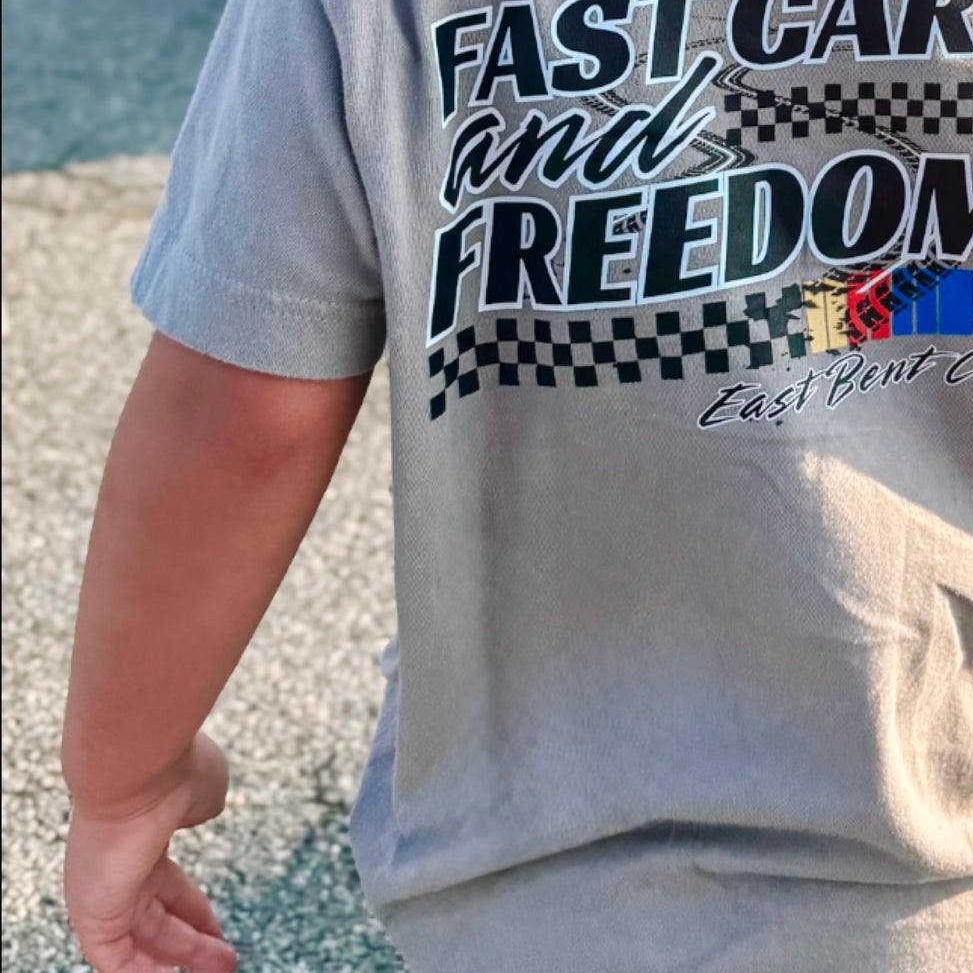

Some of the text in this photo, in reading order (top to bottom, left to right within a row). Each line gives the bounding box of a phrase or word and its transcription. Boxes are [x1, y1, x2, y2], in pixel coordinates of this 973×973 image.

[440, 50, 725, 214] and
[697, 367, 822, 429] East
[822, 345, 958, 411] Bent
